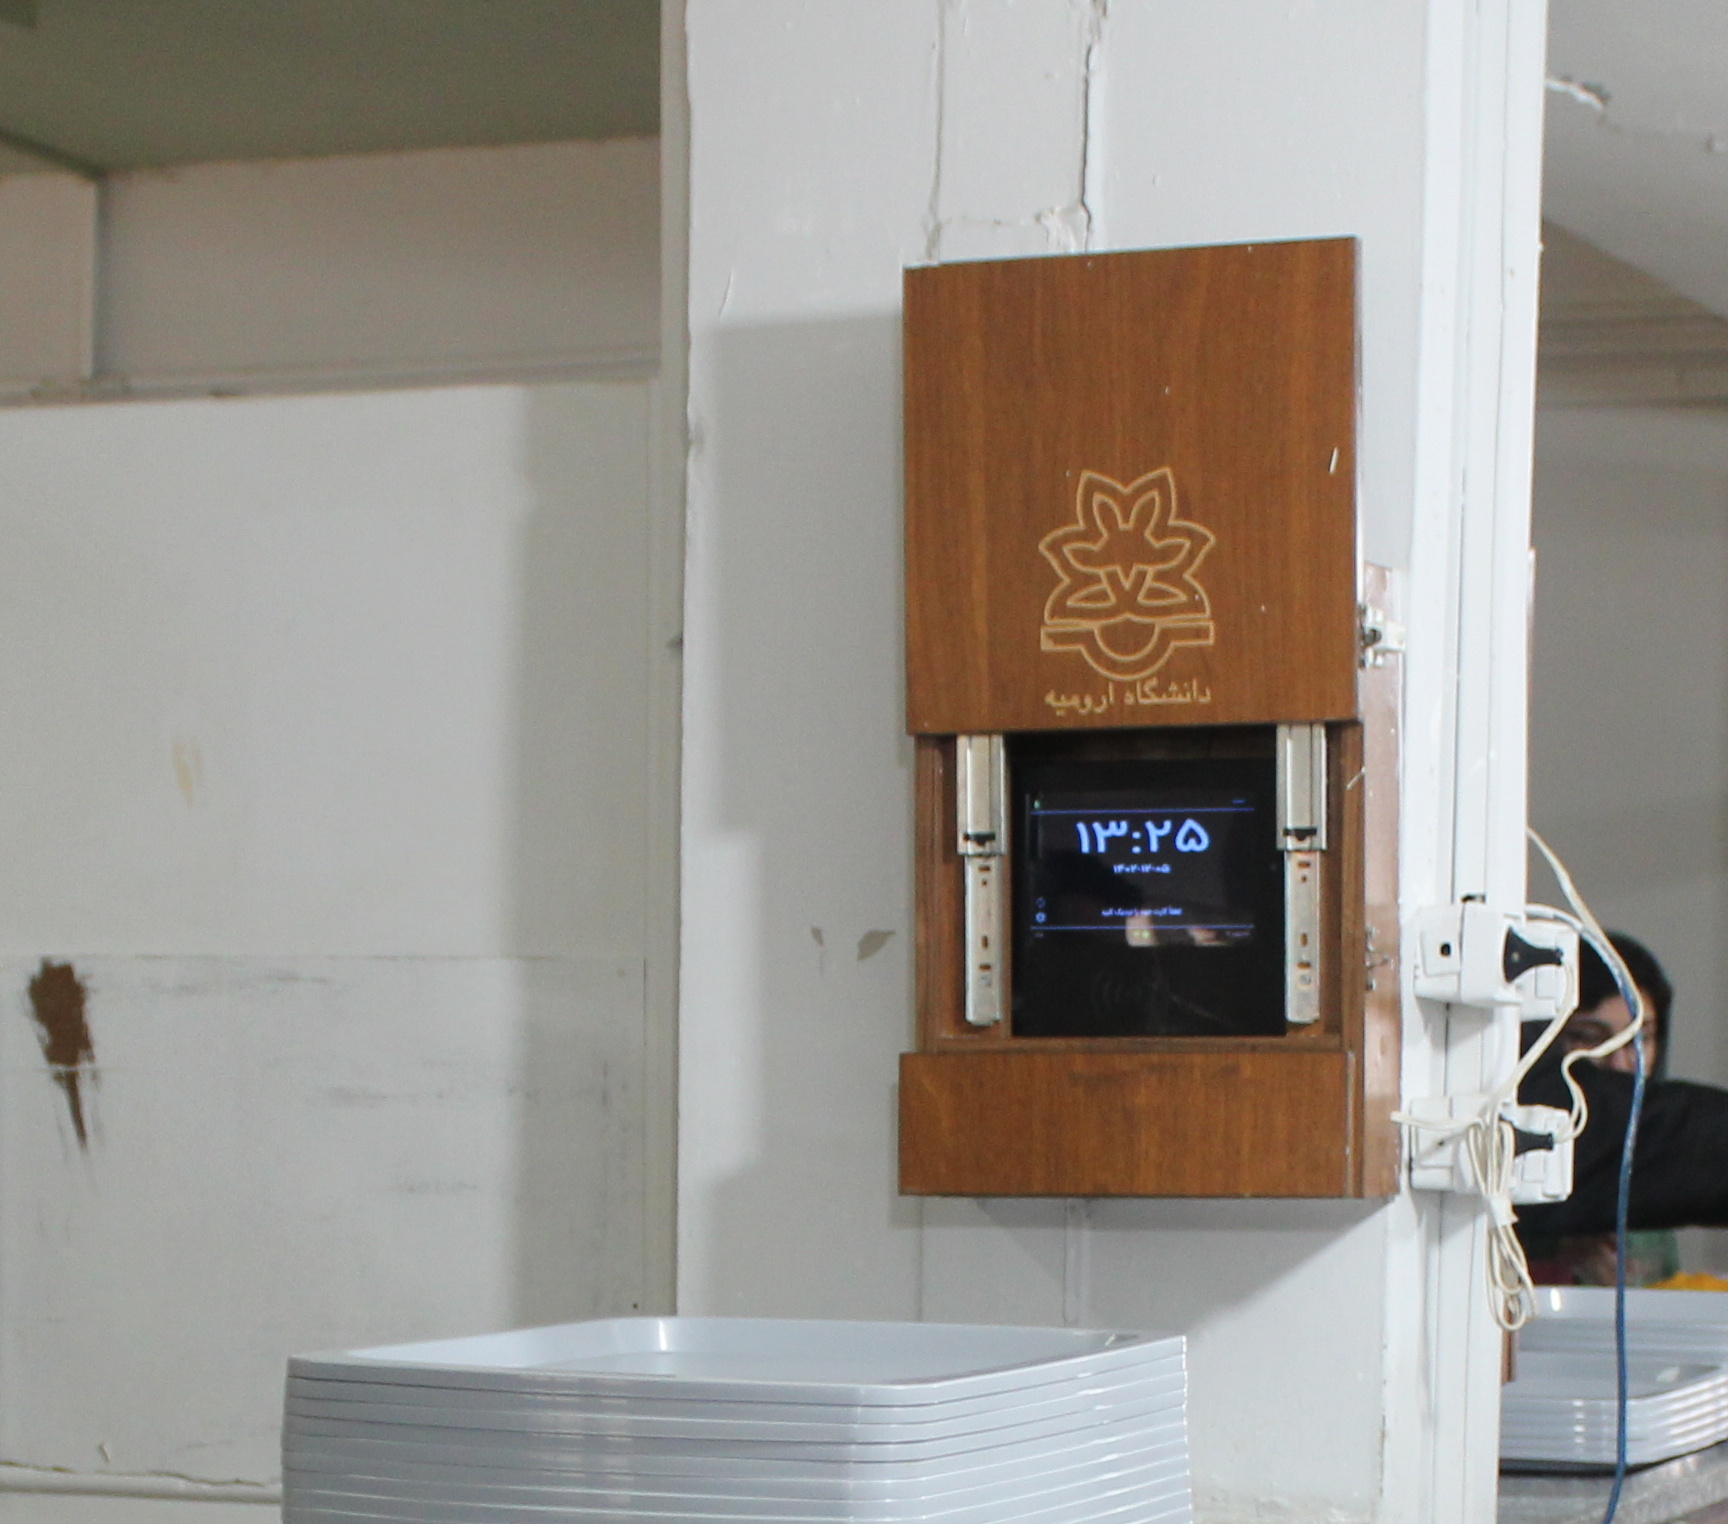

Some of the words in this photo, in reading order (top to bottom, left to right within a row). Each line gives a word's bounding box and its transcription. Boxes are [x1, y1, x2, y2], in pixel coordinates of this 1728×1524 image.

[1044, 680, 1115, 717] ارومیه
[1124, 676, 1212, 706] دانشگاه
[1076, 818, 1211, 854] ۱۳:۲۵
